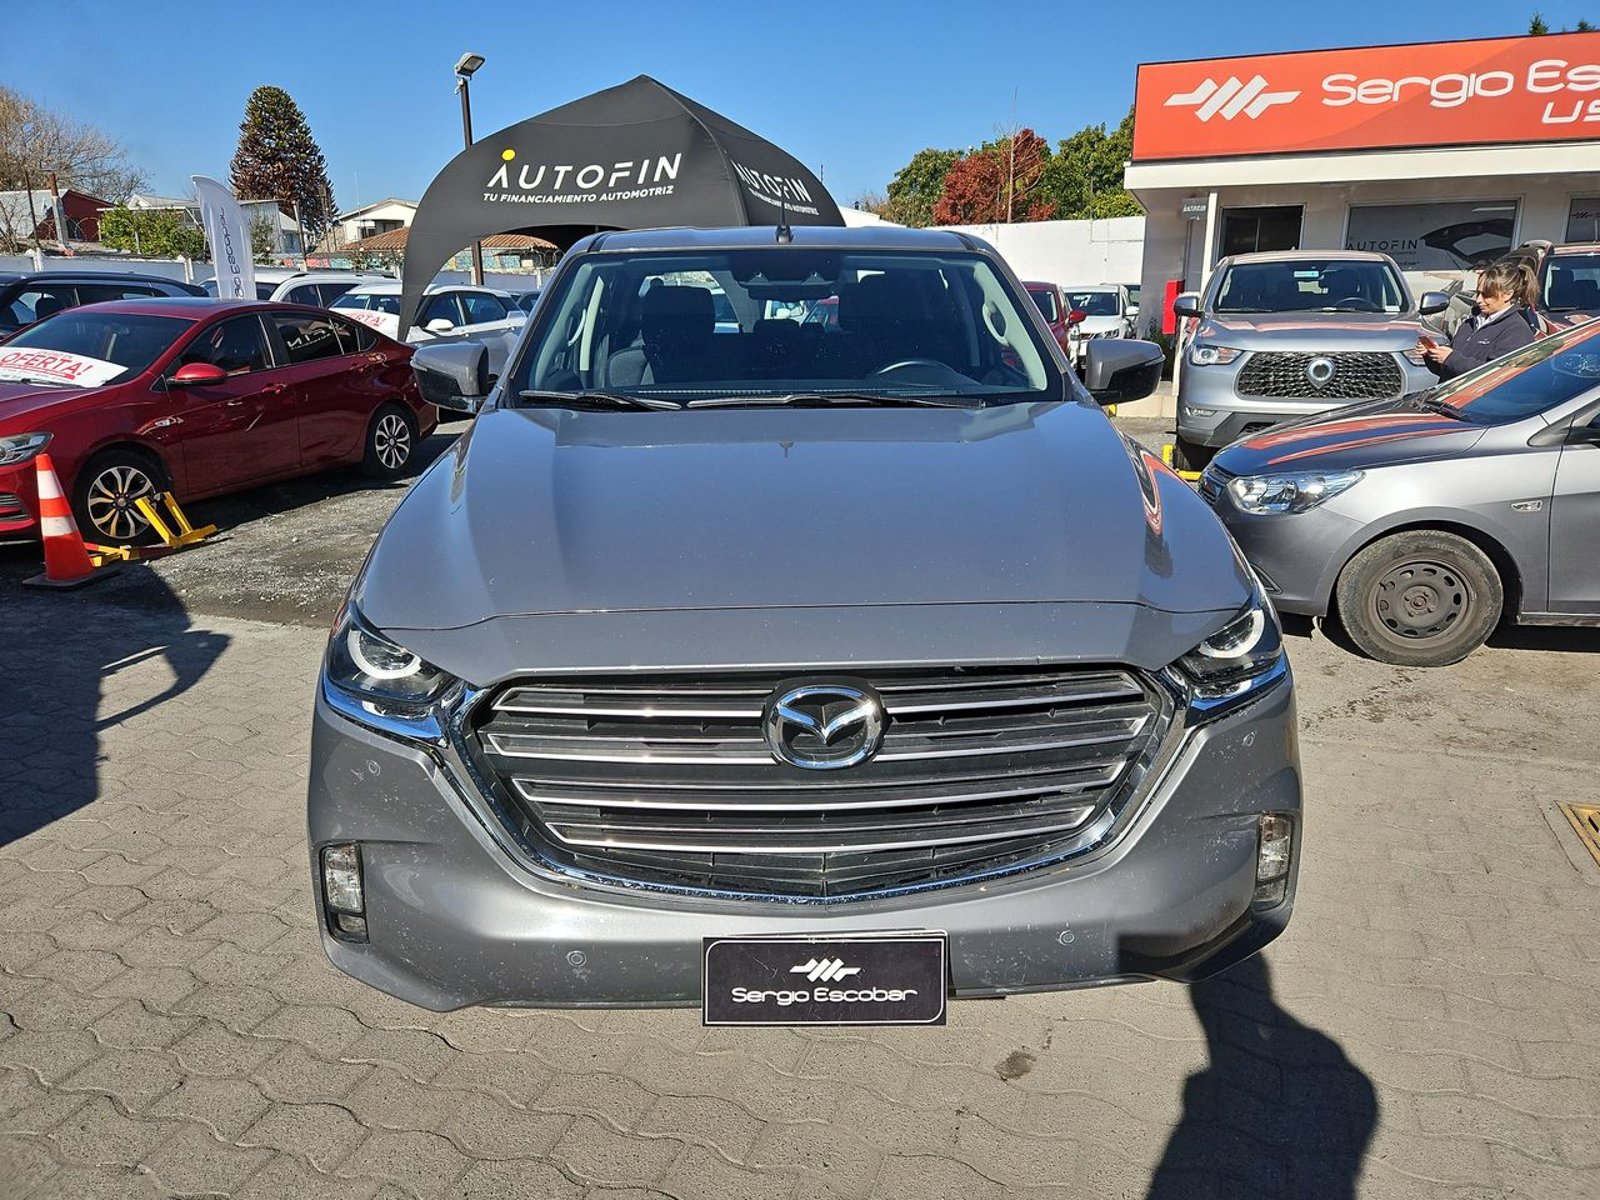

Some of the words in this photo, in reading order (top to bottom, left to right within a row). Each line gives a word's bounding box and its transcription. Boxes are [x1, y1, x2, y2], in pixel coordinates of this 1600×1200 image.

[1321, 71, 1515, 108] Sergio
[486, 150, 682, 190] AUTOFIN
[730, 160, 812, 203] AUTOFIN
[483, 193, 498, 202] TU
[500, 193, 597, 204] FINANCIAMIENTO
[598, 185, 675, 202] AUTOMOTRIZ
[1346, 240, 1418, 251] AUTOFIN
[1, 352, 94, 376] OFERTA!
[731, 986, 810, 1006] Sergio
[813, 986, 918, 1002] Escobar
